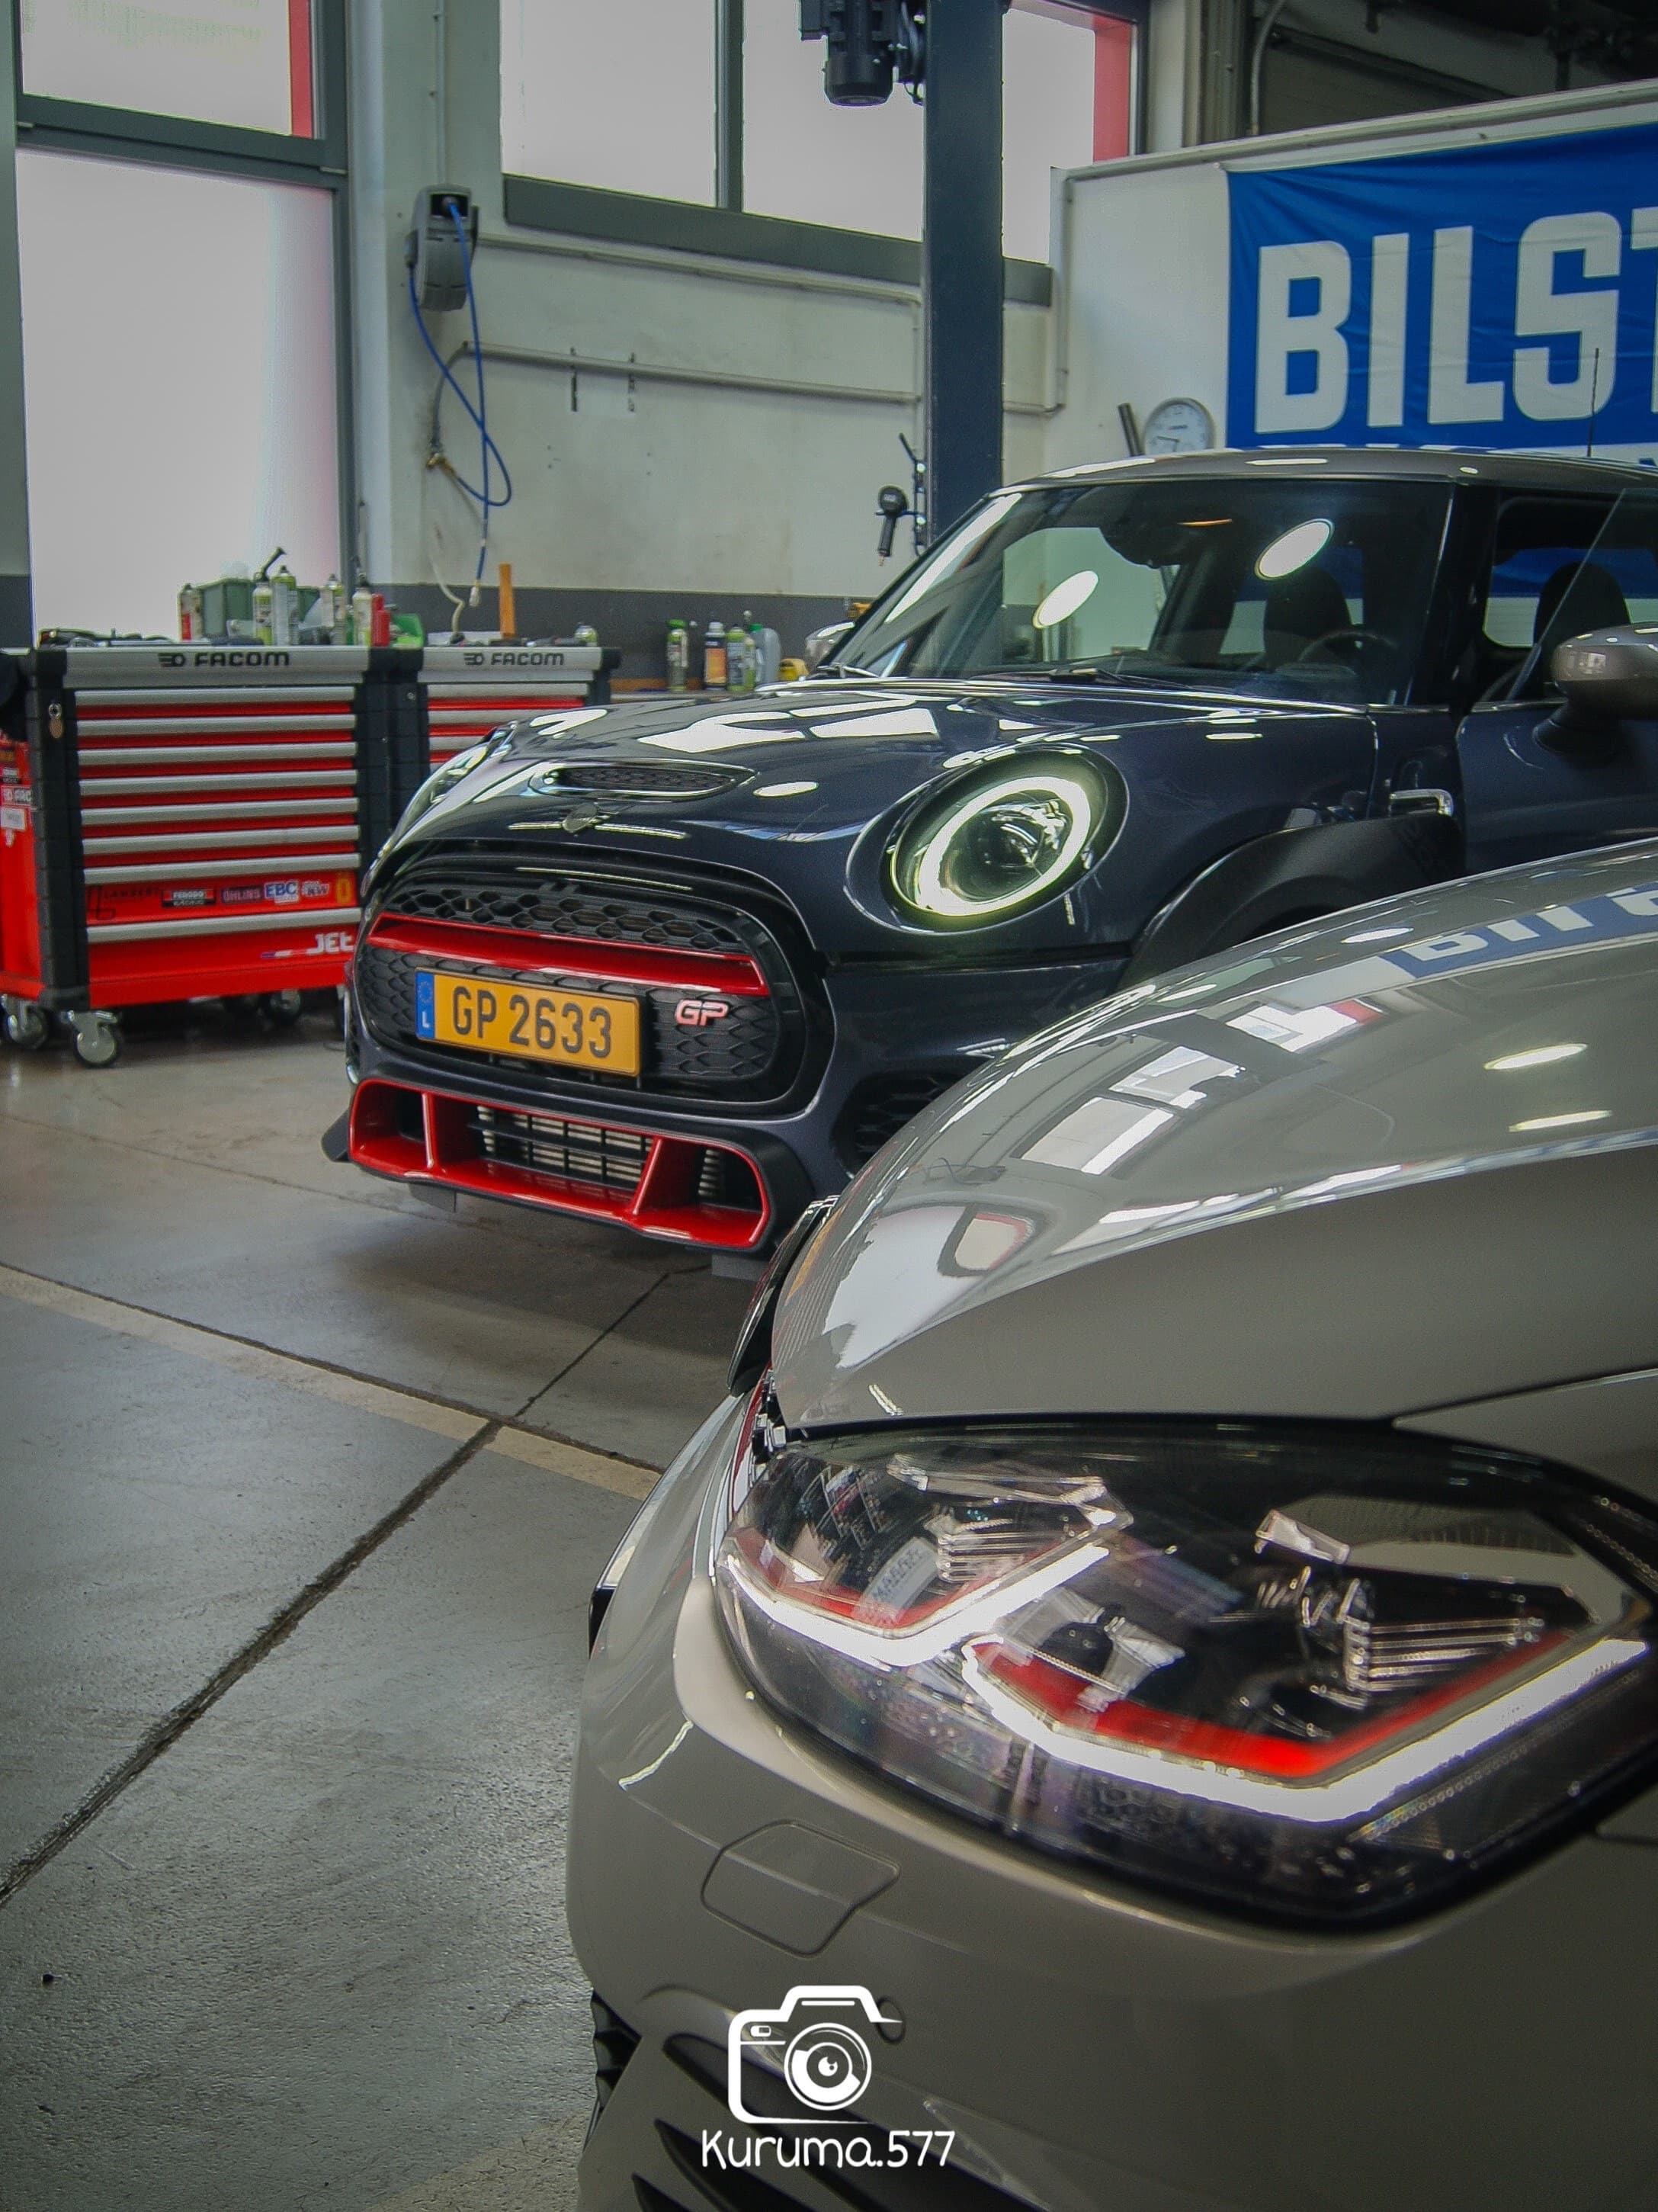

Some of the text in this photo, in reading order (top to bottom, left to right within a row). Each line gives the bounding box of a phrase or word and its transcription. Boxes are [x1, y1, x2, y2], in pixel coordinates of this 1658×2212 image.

[194, 652, 290, 667] FACOM
[491, 653, 564, 666] FACOM
[266, 881, 297, 897] EBC
[422, 1011, 430, 1029] L
[675, 1000, 729, 1026] GP
[453, 986, 611, 1058] GP 2633
